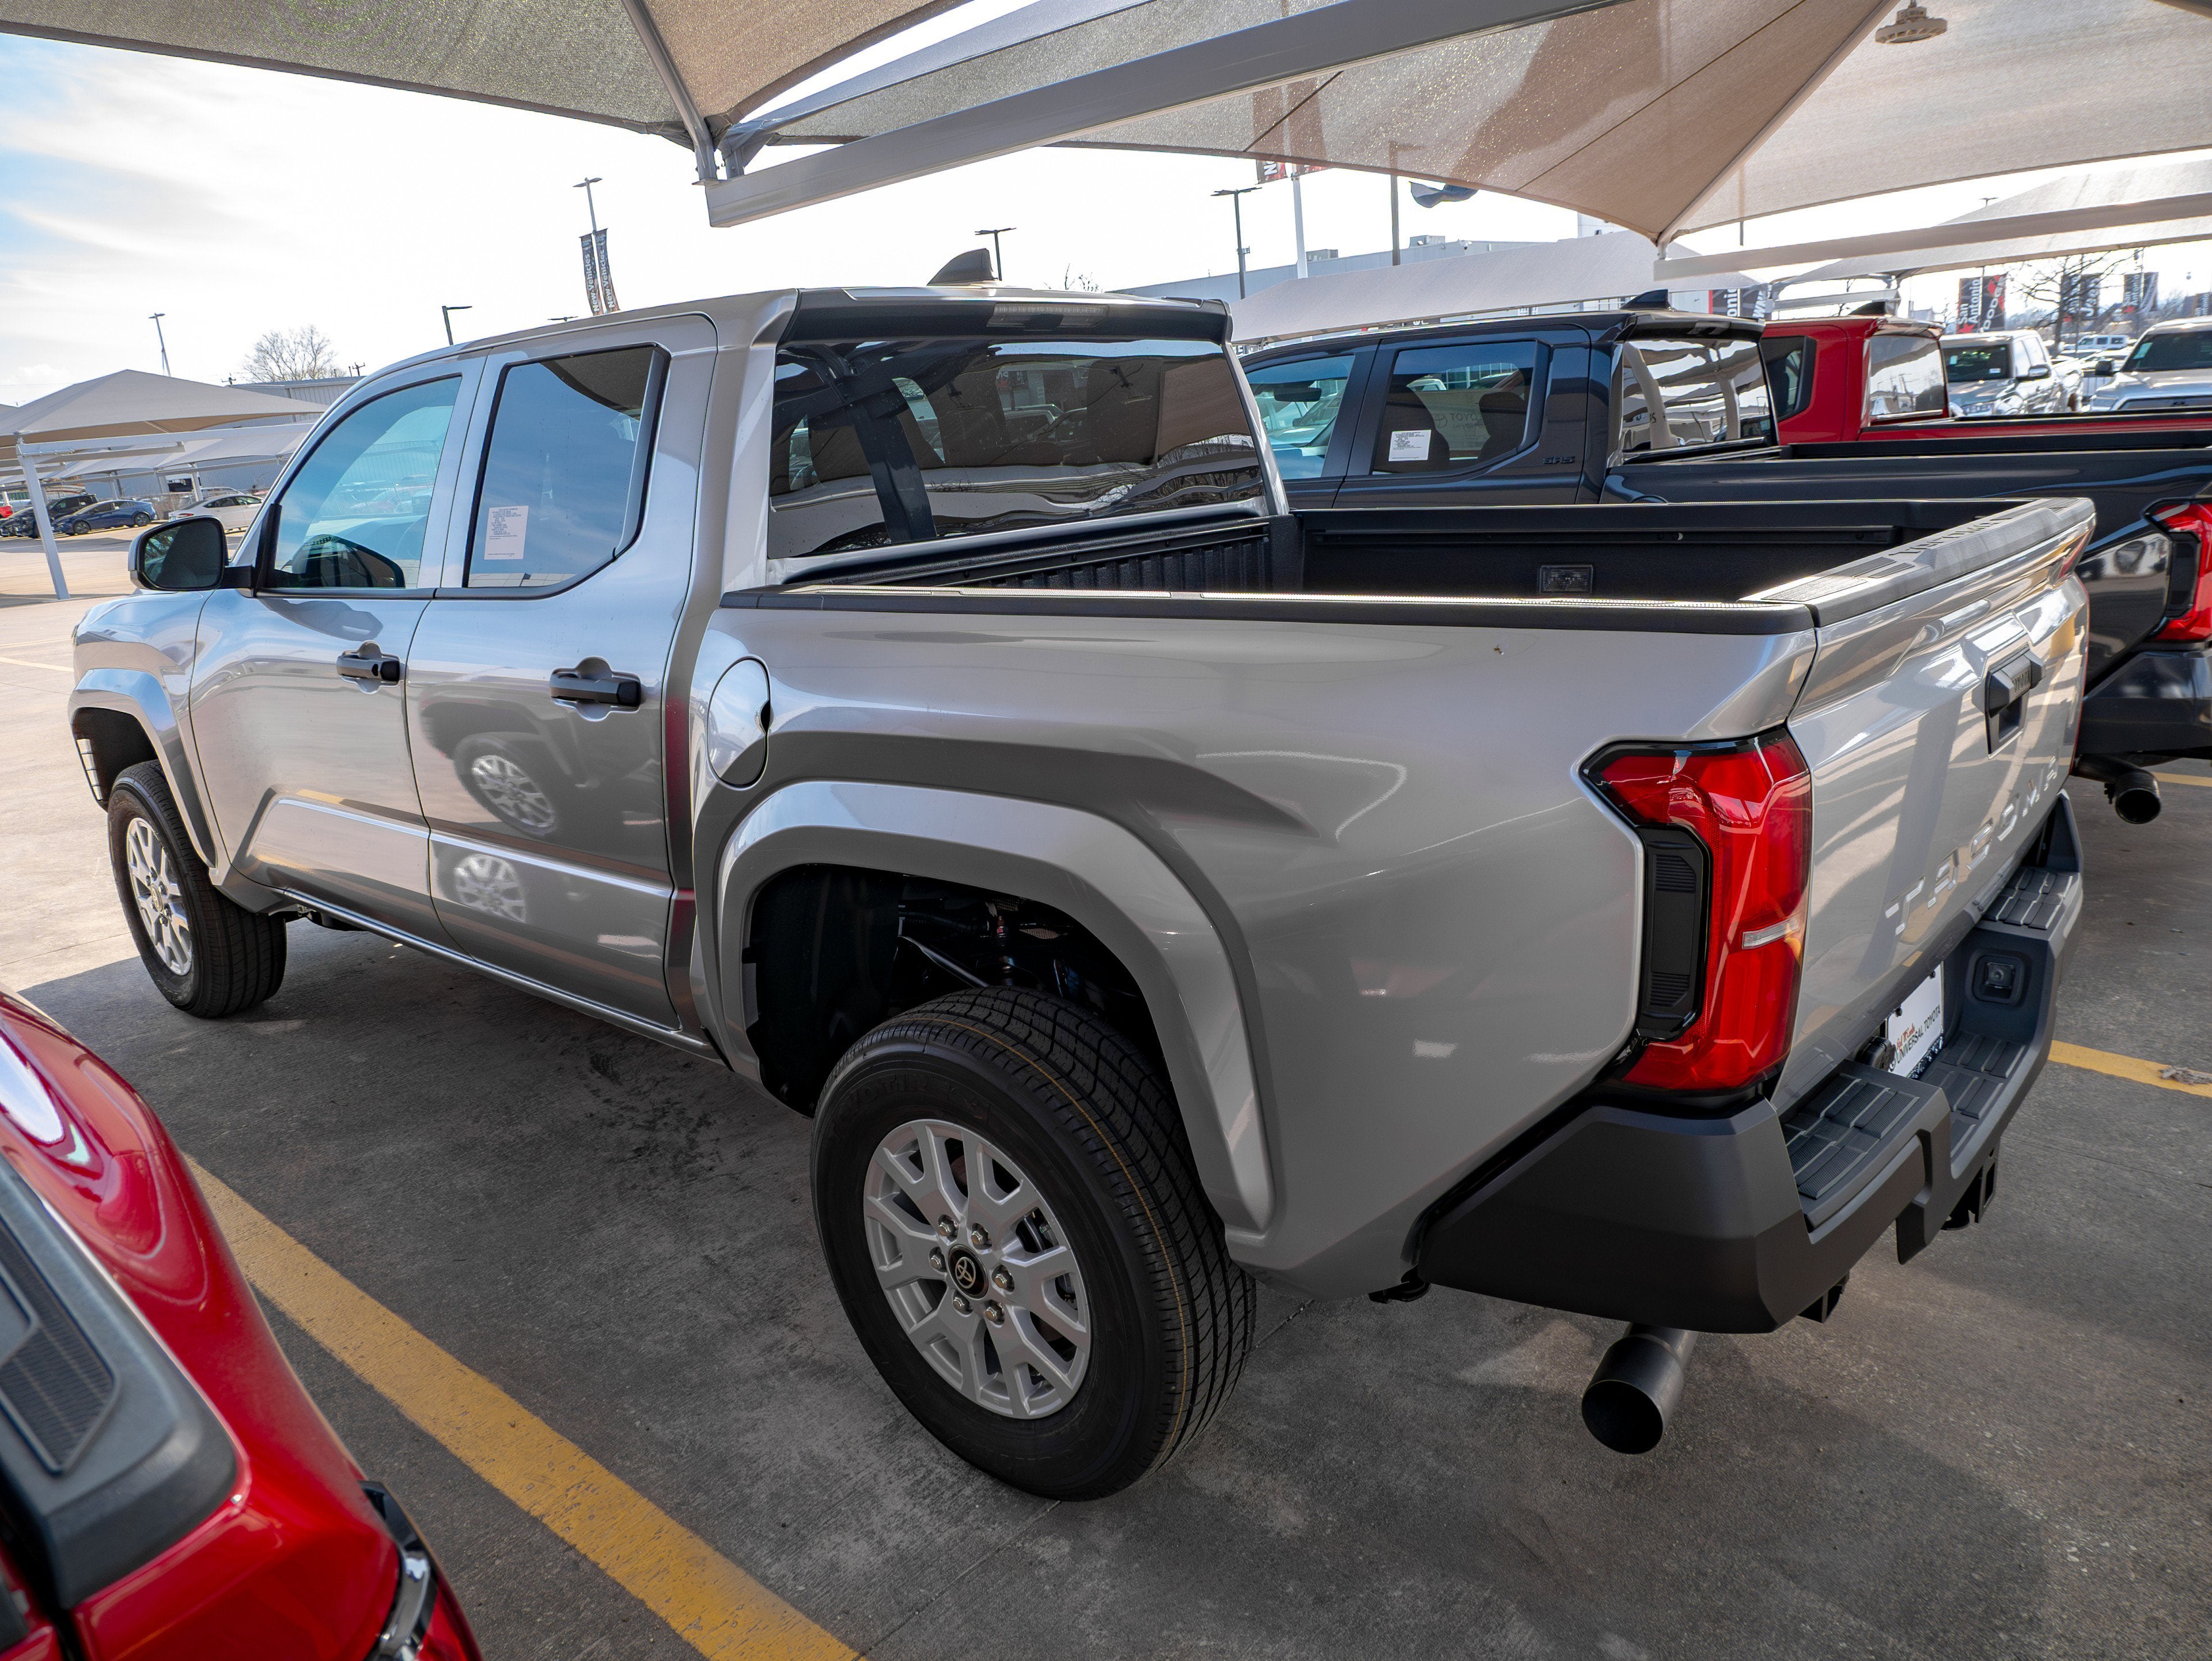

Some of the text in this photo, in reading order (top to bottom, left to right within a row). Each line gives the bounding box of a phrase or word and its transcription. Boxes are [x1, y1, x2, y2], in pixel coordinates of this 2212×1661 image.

[591, 293, 600, 312] New
[605, 289, 615, 309] New
[1957, 303, 1969, 324] San
[1968, 279, 1980, 323] Antonio
[1885, 751, 2058, 937] TACOMA
[1897, 1026, 1923, 1064] UNIVERSAL
[1924, 1004, 1941, 1032] TOYOTA
